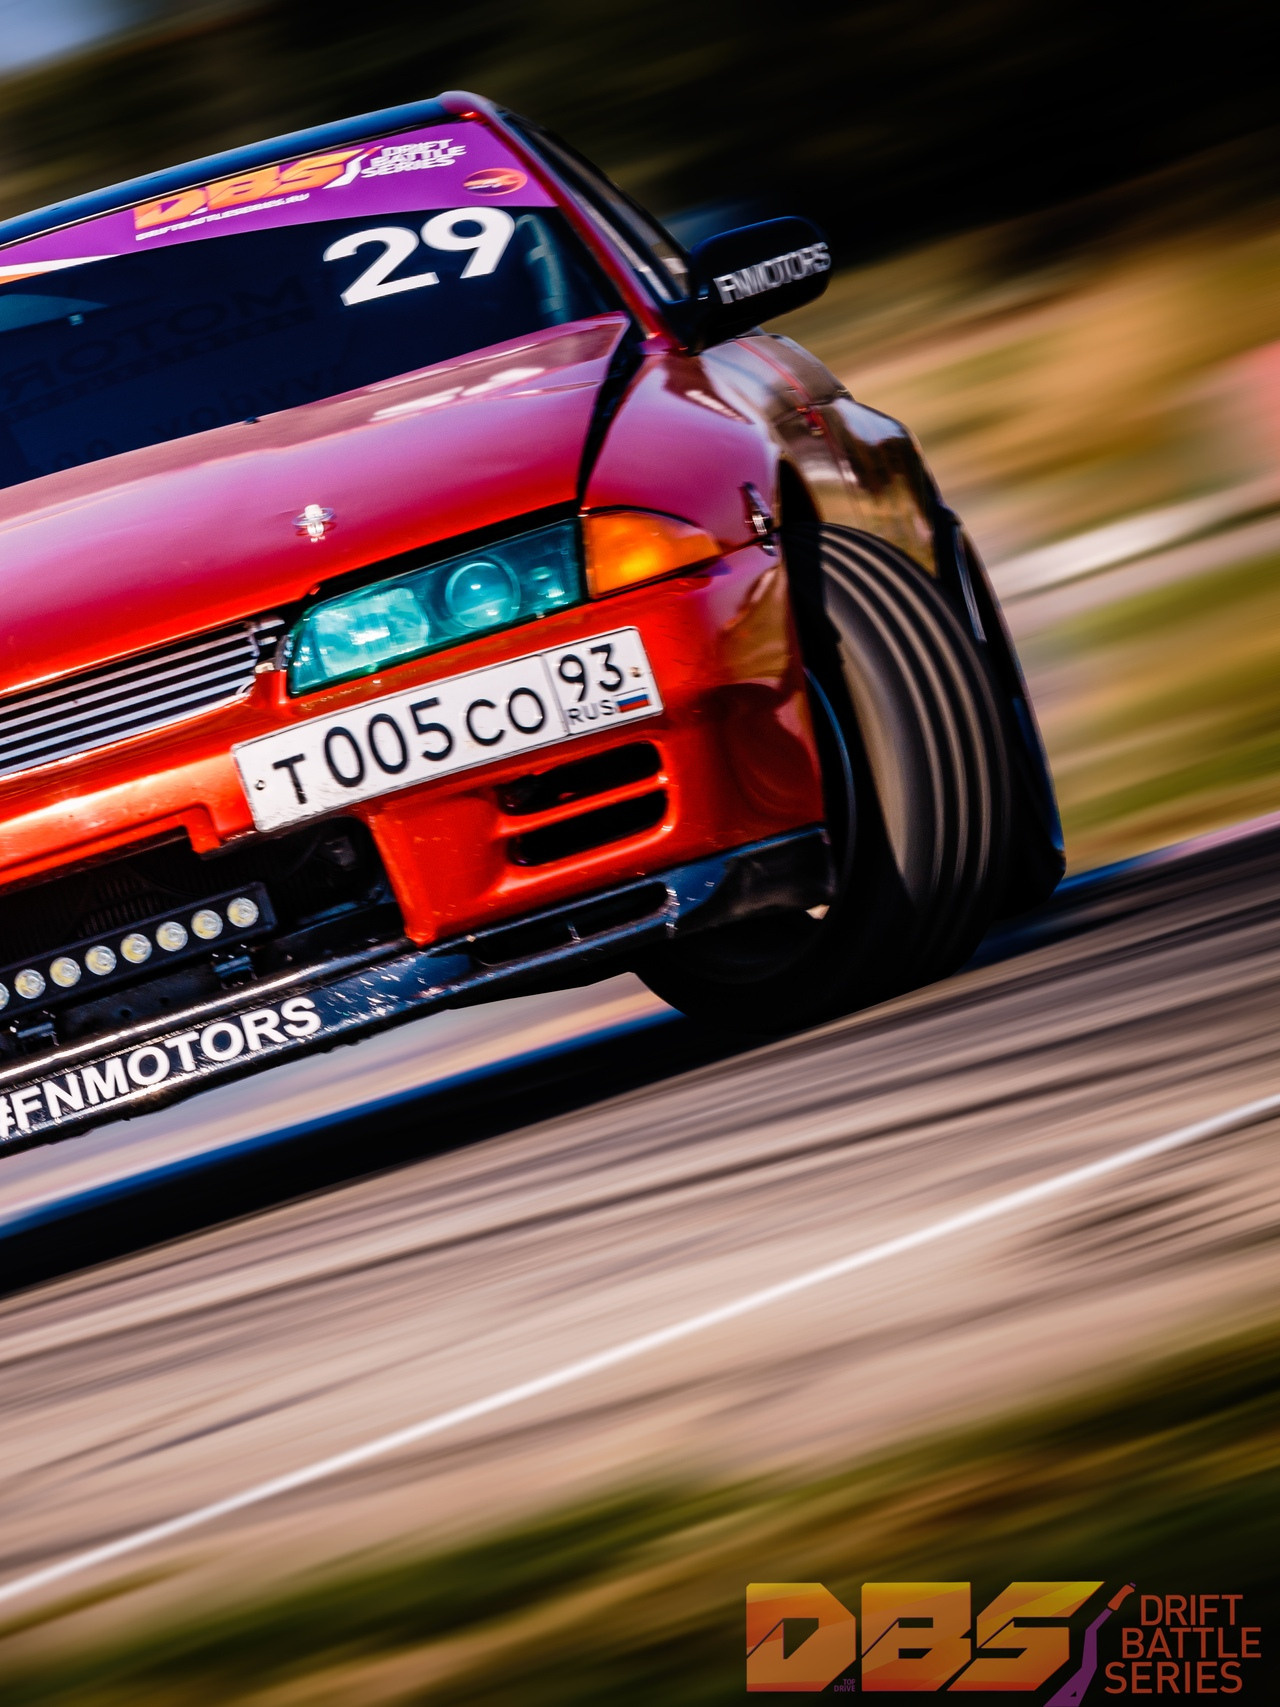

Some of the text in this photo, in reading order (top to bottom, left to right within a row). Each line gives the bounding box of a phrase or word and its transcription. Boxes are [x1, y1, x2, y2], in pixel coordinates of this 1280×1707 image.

[370, 145, 467, 165] BATTLE
[381, 139, 454, 157] DRIFT
[361, 158, 456, 178] SERIES
[133, 148, 365, 230] DBS
[323, 207, 516, 306] 29
[558, 643, 625, 703] 93
[568, 699, 617, 726] RUS
